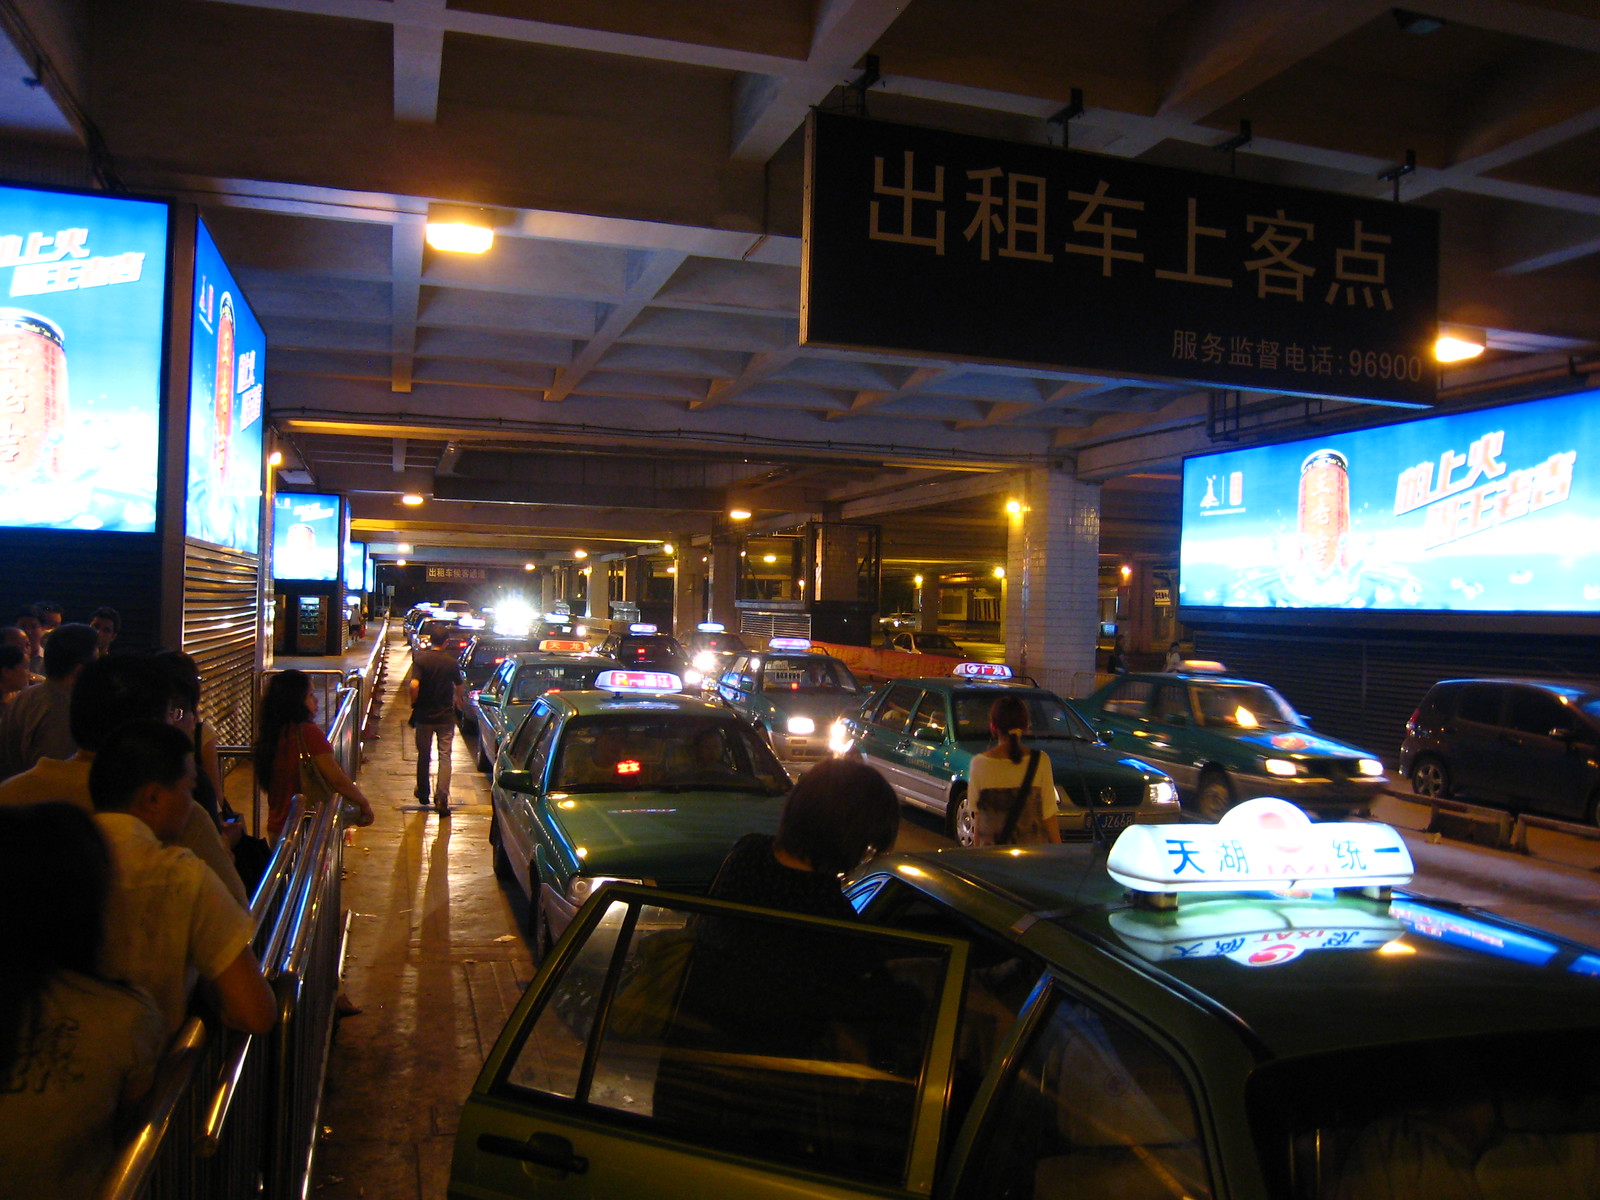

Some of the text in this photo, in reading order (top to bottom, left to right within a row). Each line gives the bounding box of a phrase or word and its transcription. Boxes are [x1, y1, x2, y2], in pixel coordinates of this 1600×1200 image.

[868, 150, 1394, 311] 出租车上客点
